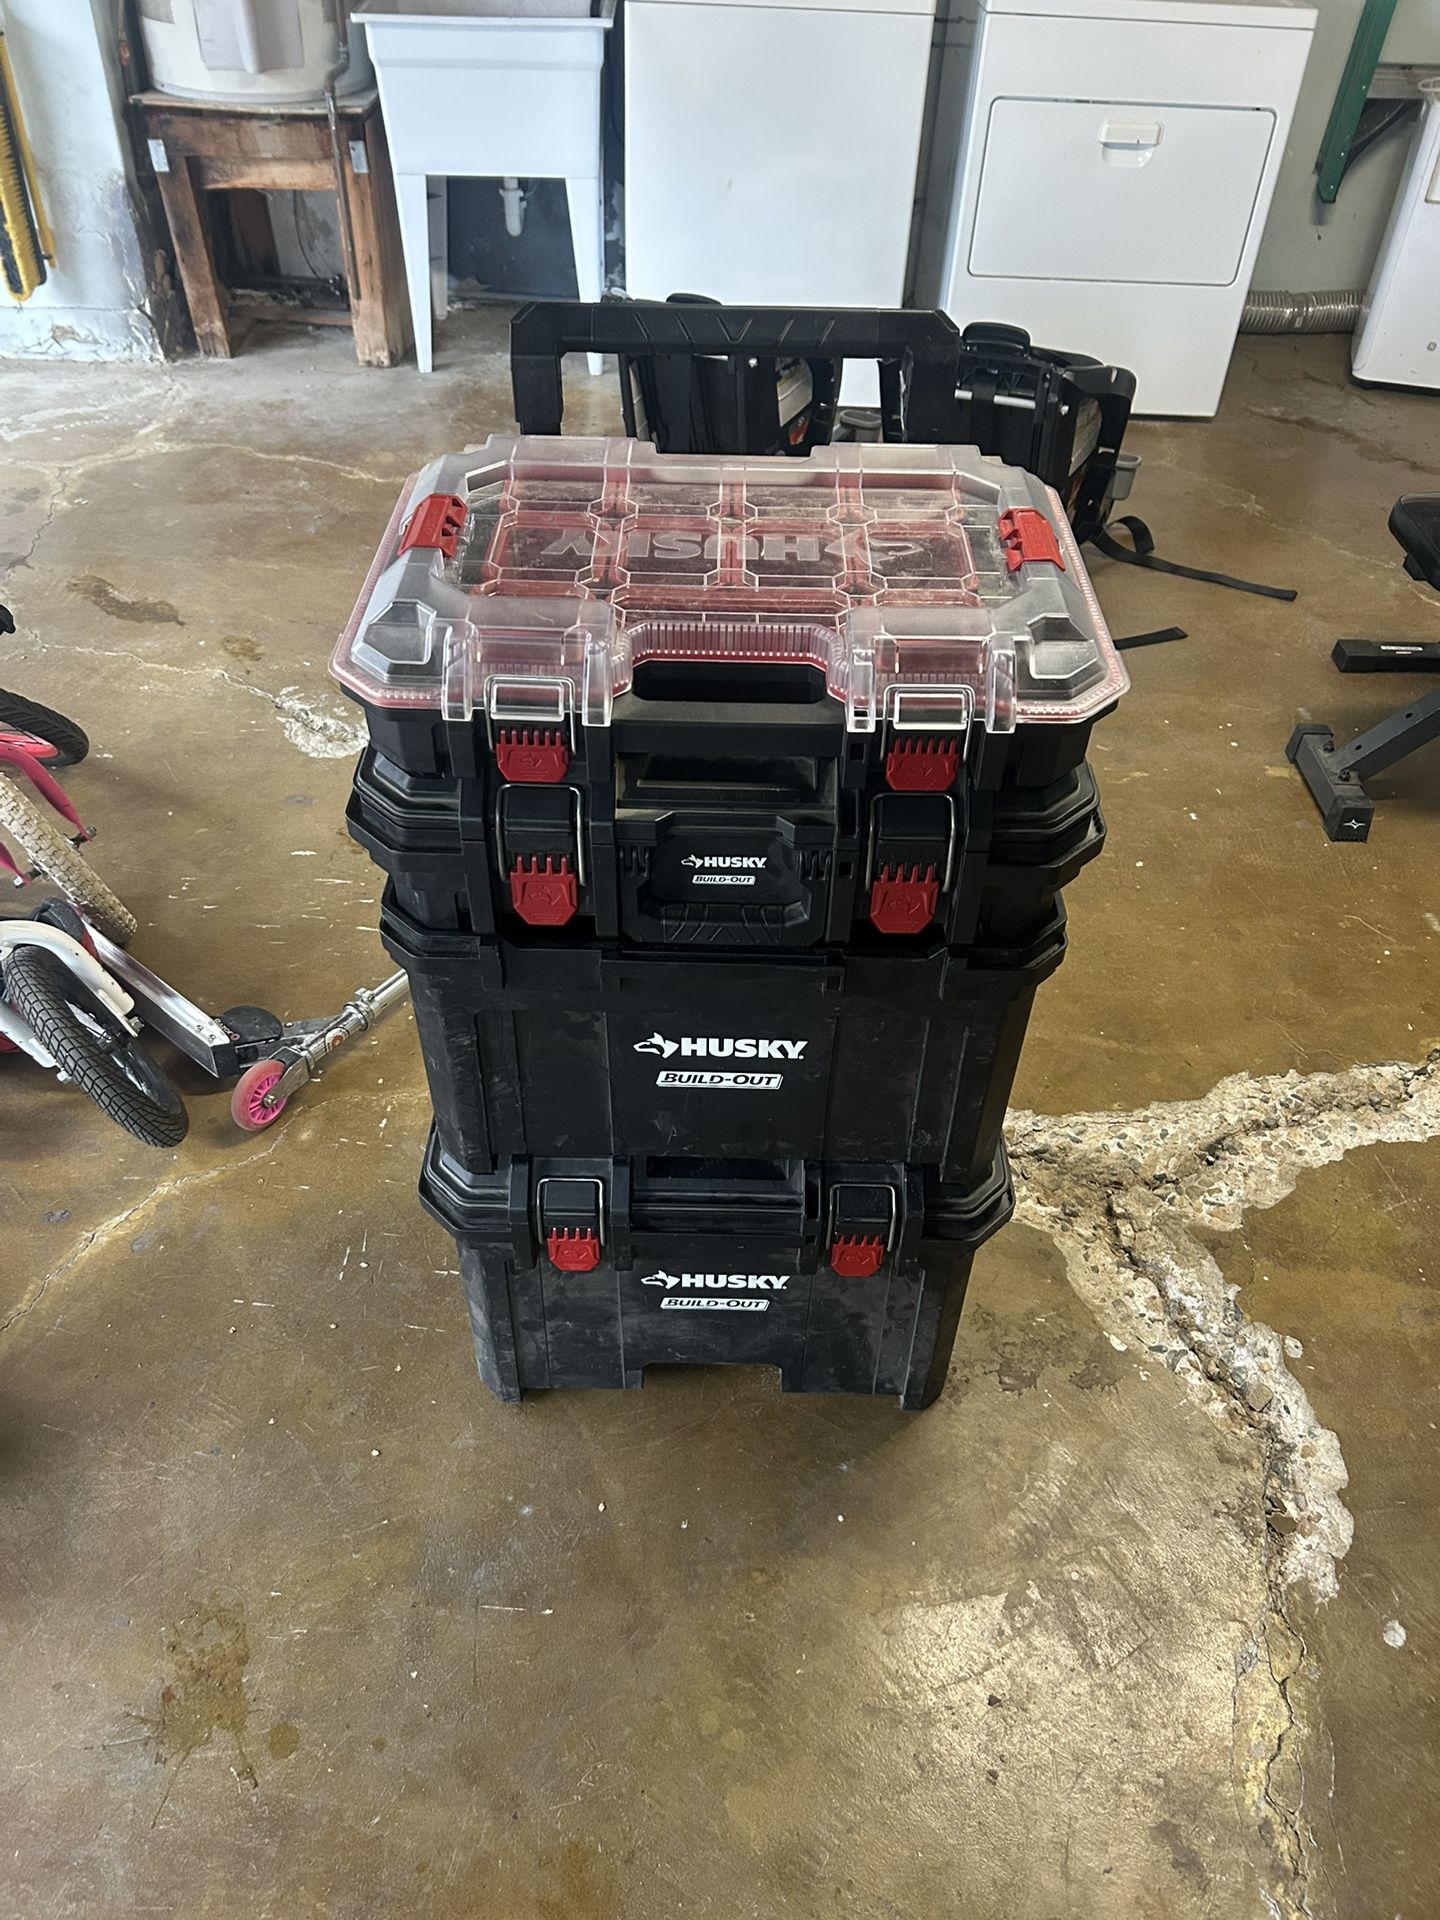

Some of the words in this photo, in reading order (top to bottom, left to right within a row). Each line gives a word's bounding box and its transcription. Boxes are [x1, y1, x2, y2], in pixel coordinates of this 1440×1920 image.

[540, 530, 820, 561] HUSKY
[695, 875, 752, 883] BUILD-OUT
[661, 1072, 778, 1086] BUILD-OUT
[664, 1298, 765, 1309] BUILD-OUT
